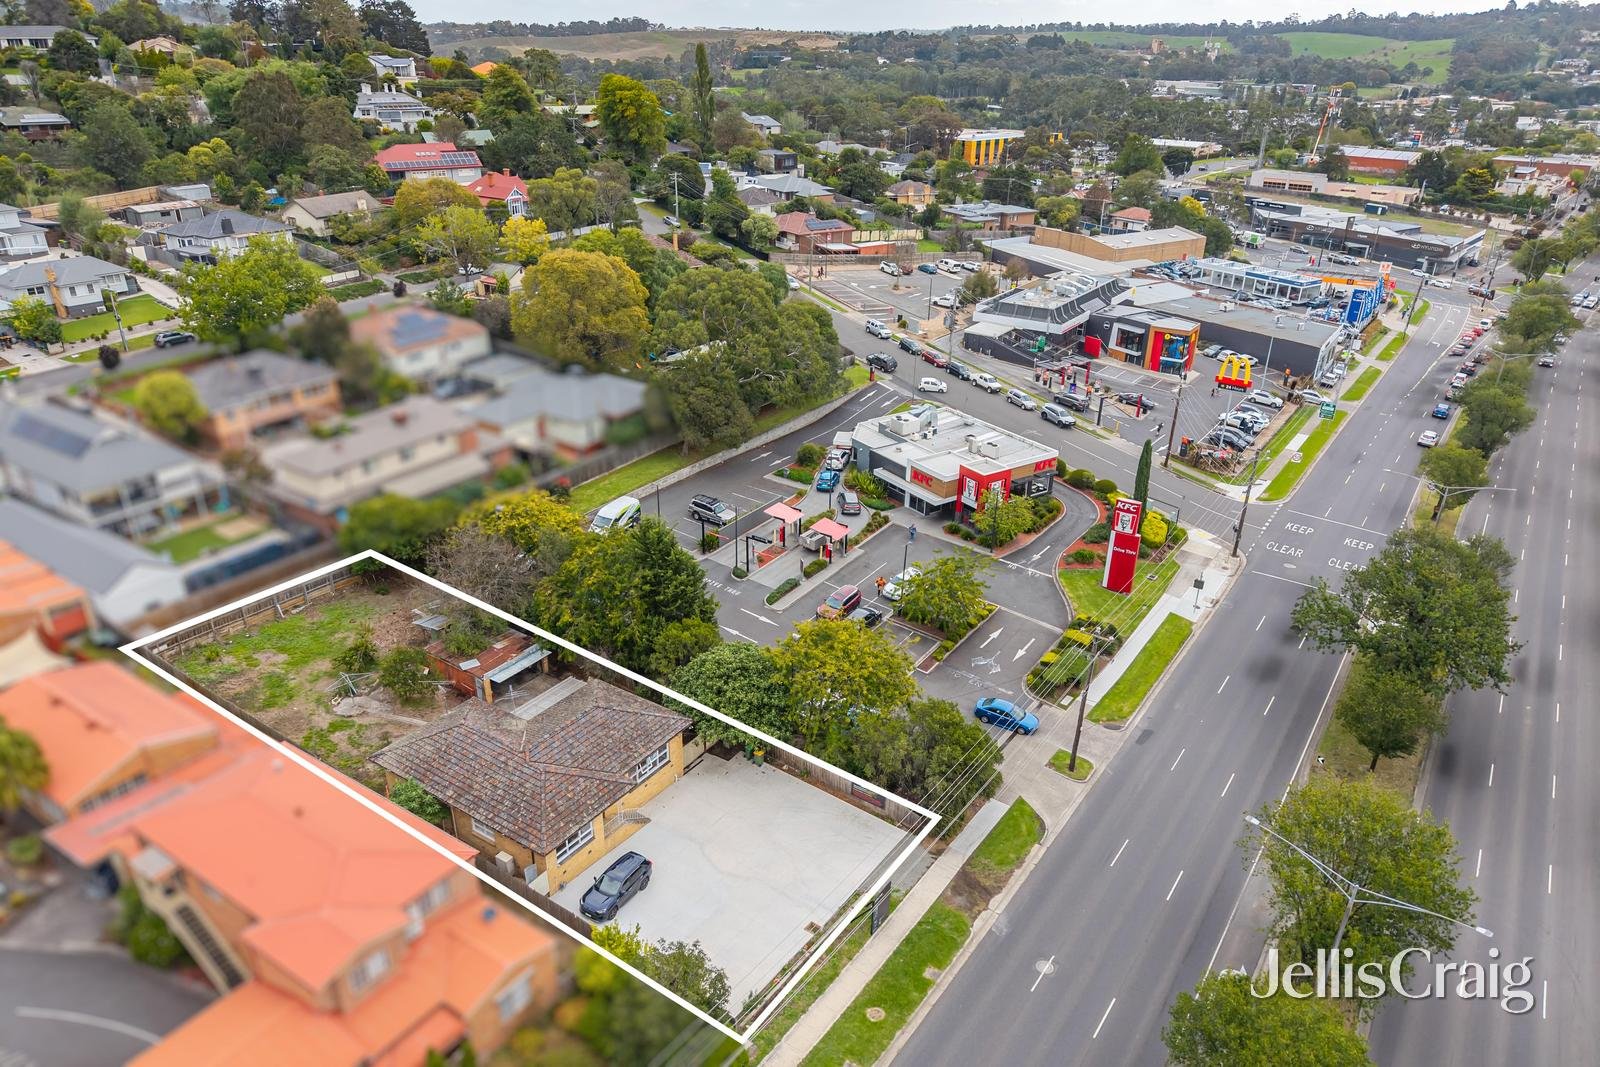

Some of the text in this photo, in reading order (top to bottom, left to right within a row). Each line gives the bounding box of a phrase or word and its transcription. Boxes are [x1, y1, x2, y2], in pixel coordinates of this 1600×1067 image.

[1034, 459, 1056, 473] KFC
[912, 470, 933, 487] KFC
[1117, 502, 1138, 512] KFC
[1285, 522, 1314, 535] KEEP
[1266, 541, 1304, 558] CLEAR
[1343, 537, 1374, 551] KEEP
